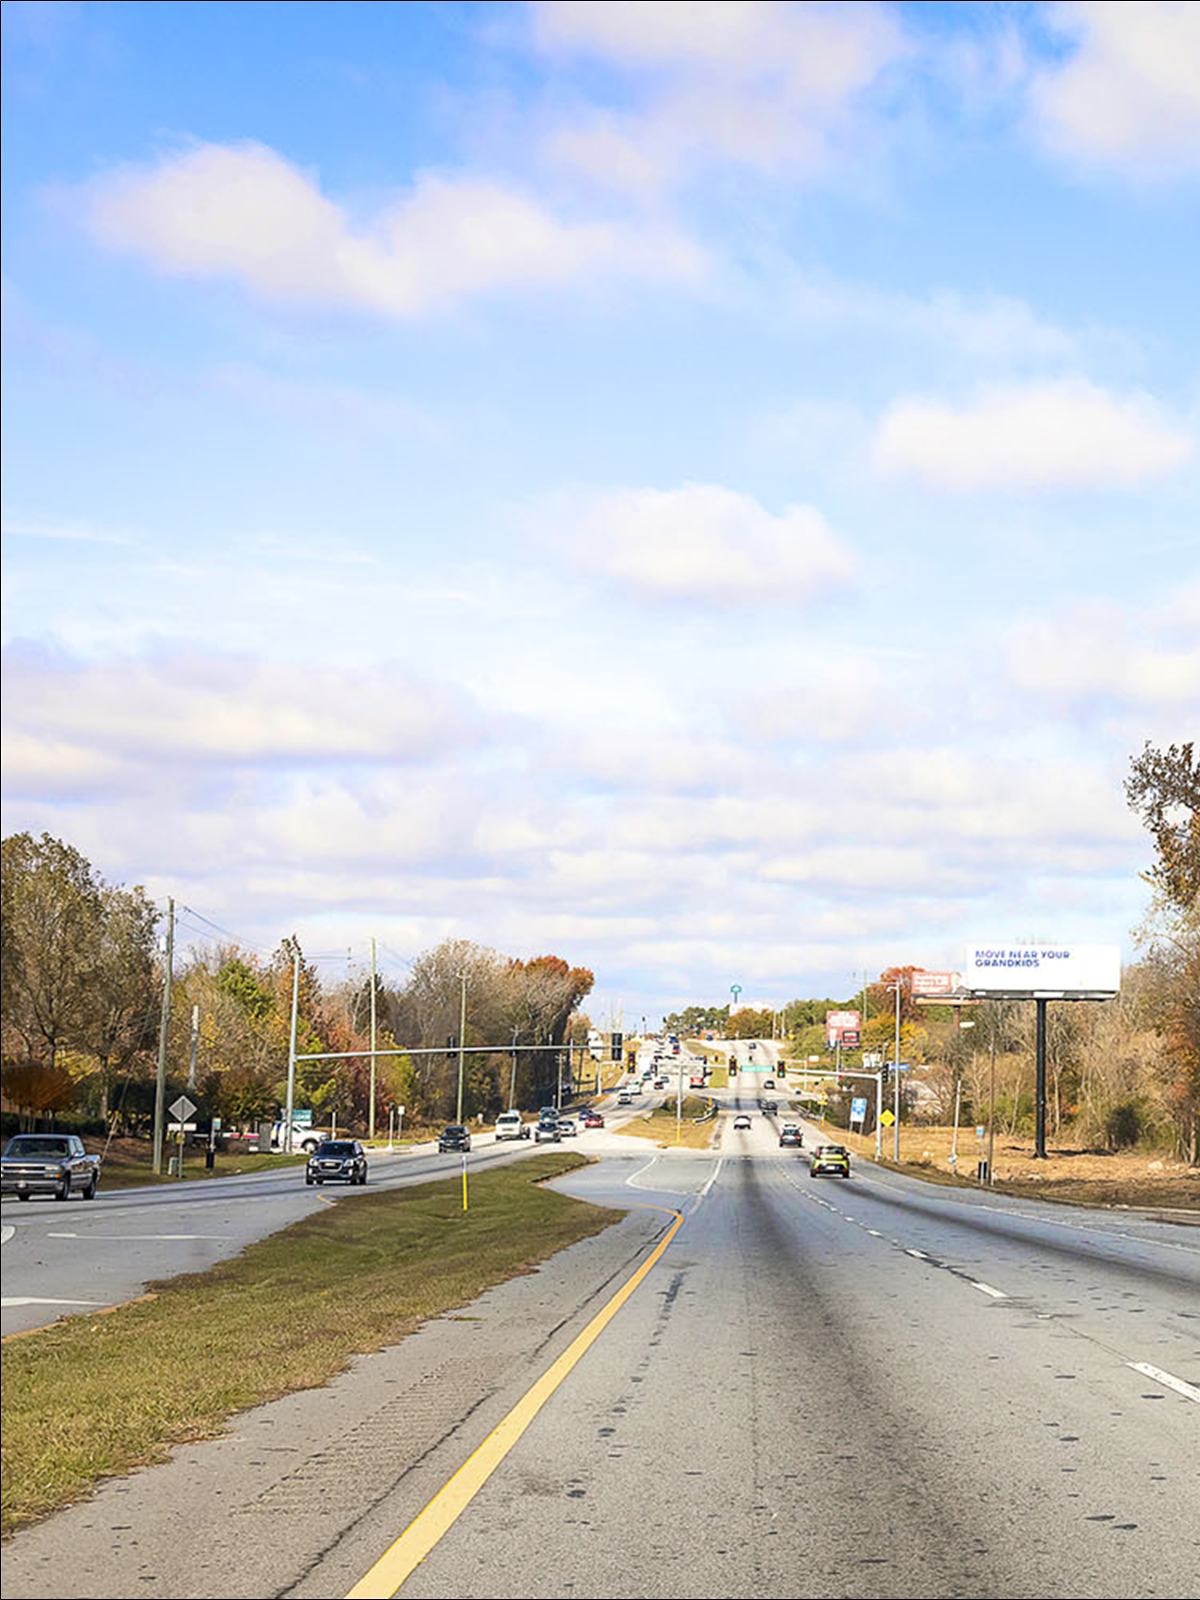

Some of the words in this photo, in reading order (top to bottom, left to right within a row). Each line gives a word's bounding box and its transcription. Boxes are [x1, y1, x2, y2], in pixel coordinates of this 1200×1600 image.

[975, 950, 1005, 959] MOVE
[1009, 950, 1038, 959] NEAR
[1041, 950, 1069, 959] YOUR
[975, 959, 1040, 967] GRANDKIDS
